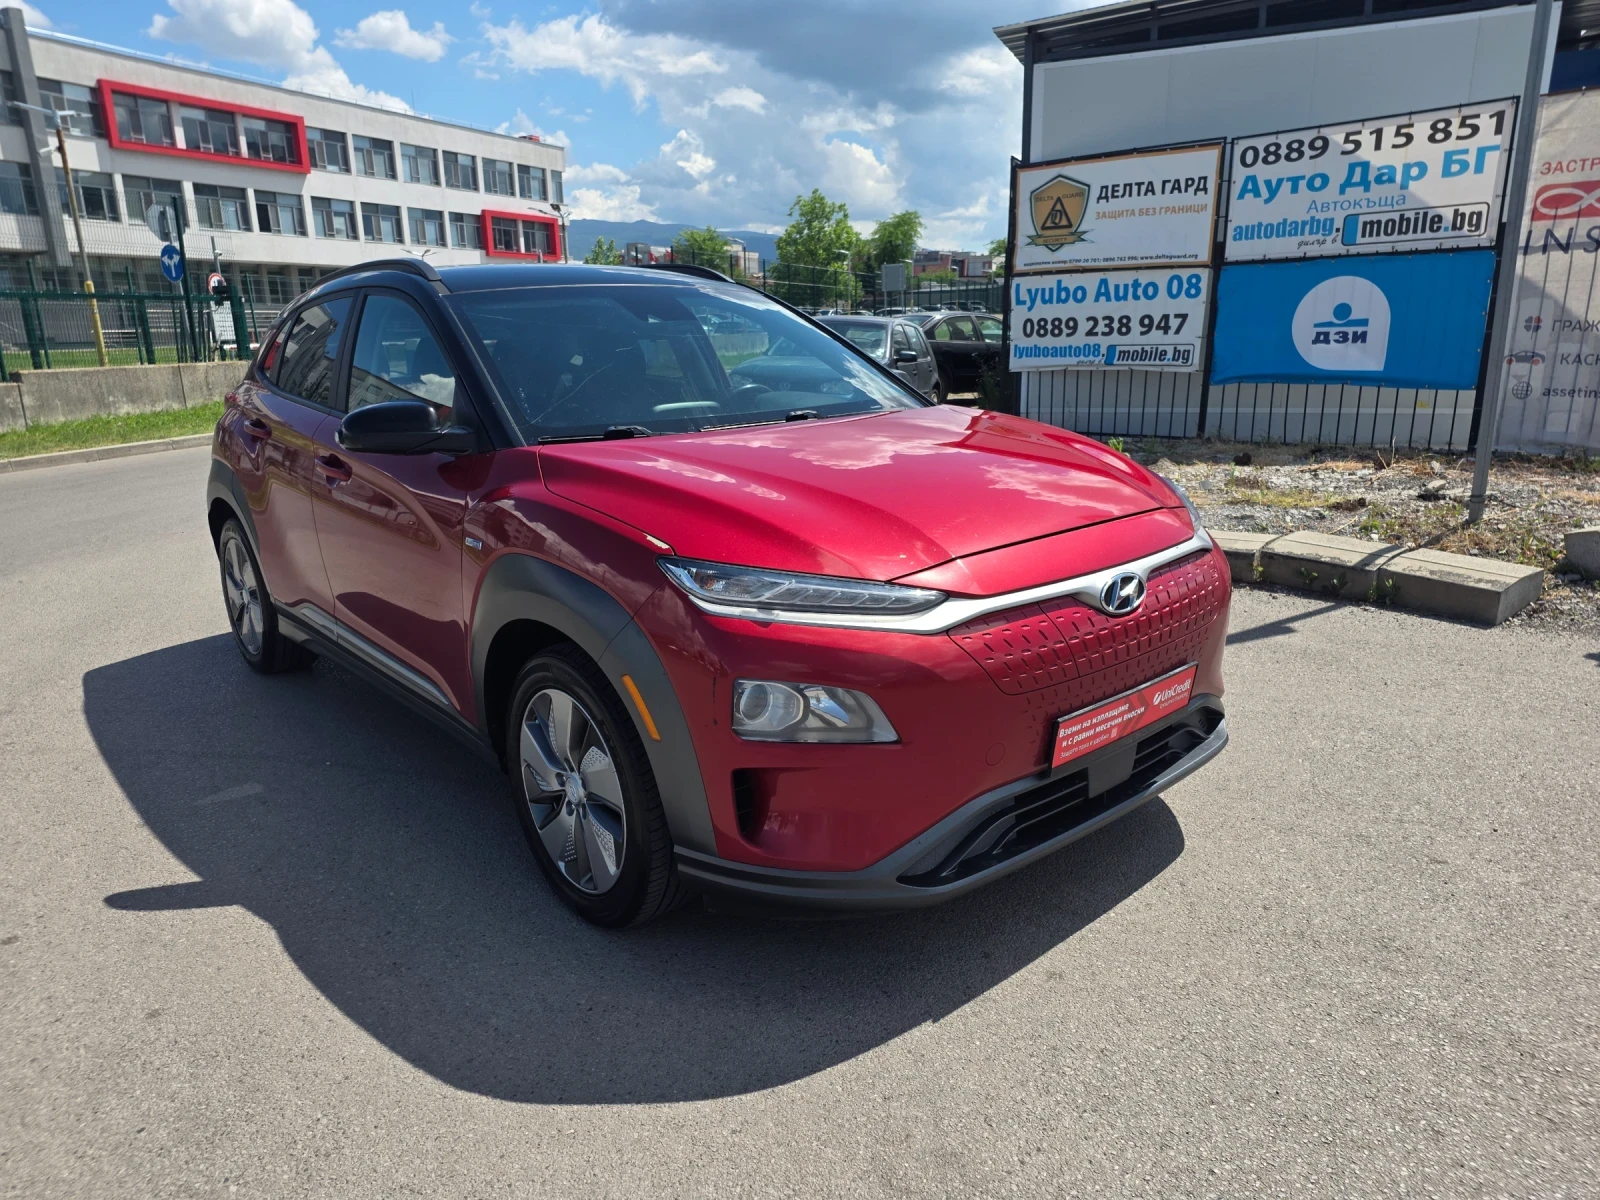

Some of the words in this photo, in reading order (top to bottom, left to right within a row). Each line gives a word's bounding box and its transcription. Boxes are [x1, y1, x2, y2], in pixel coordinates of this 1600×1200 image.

[1239, 135, 1330, 168] 0889
[1340, 123, 1415, 155] 515
[1427, 110, 1506, 144] 851
[1236, 172, 1330, 205] Ауто
[1338, 160, 1428, 196] Дар
[1441, 144, 1501, 178] БГ
[1540, 157, 1600, 175] ЗАСТР
[1096, 181, 1156, 204] ДЕЛТА
[1161, 175, 1208, 195] ГАРД
[1095, 208, 1136, 221] ЗАЩИТА
[1138, 206, 1157, 216] БЕЗ
[1159, 203, 1208, 215] ГРАНИЦИ
[1306, 194, 1406, 214] Автокъща
[1361, 208, 1483, 238] mobile.bg
[1522, 225, 1600, 256] INS
[1140, 253, 1199, 261] www.deltaguard.org
[1014, 279, 1087, 312] Lyubo
[1094, 277, 1160, 303] Auto
[1166, 273, 1202, 300] 08
[1022, 316, 1079, 338] 0889
[1085, 314, 1132, 337] 238
[1138, 313, 1189, 336] 947
[1552, 319, 1600, 332] ГРАЖ
[1311, 330, 1368, 345] ДЗИ
[1117, 346, 1191, 364] mobile.bg
[1162, 678, 1191, 701] UniCredit
[1082, 720, 1091, 728] на
